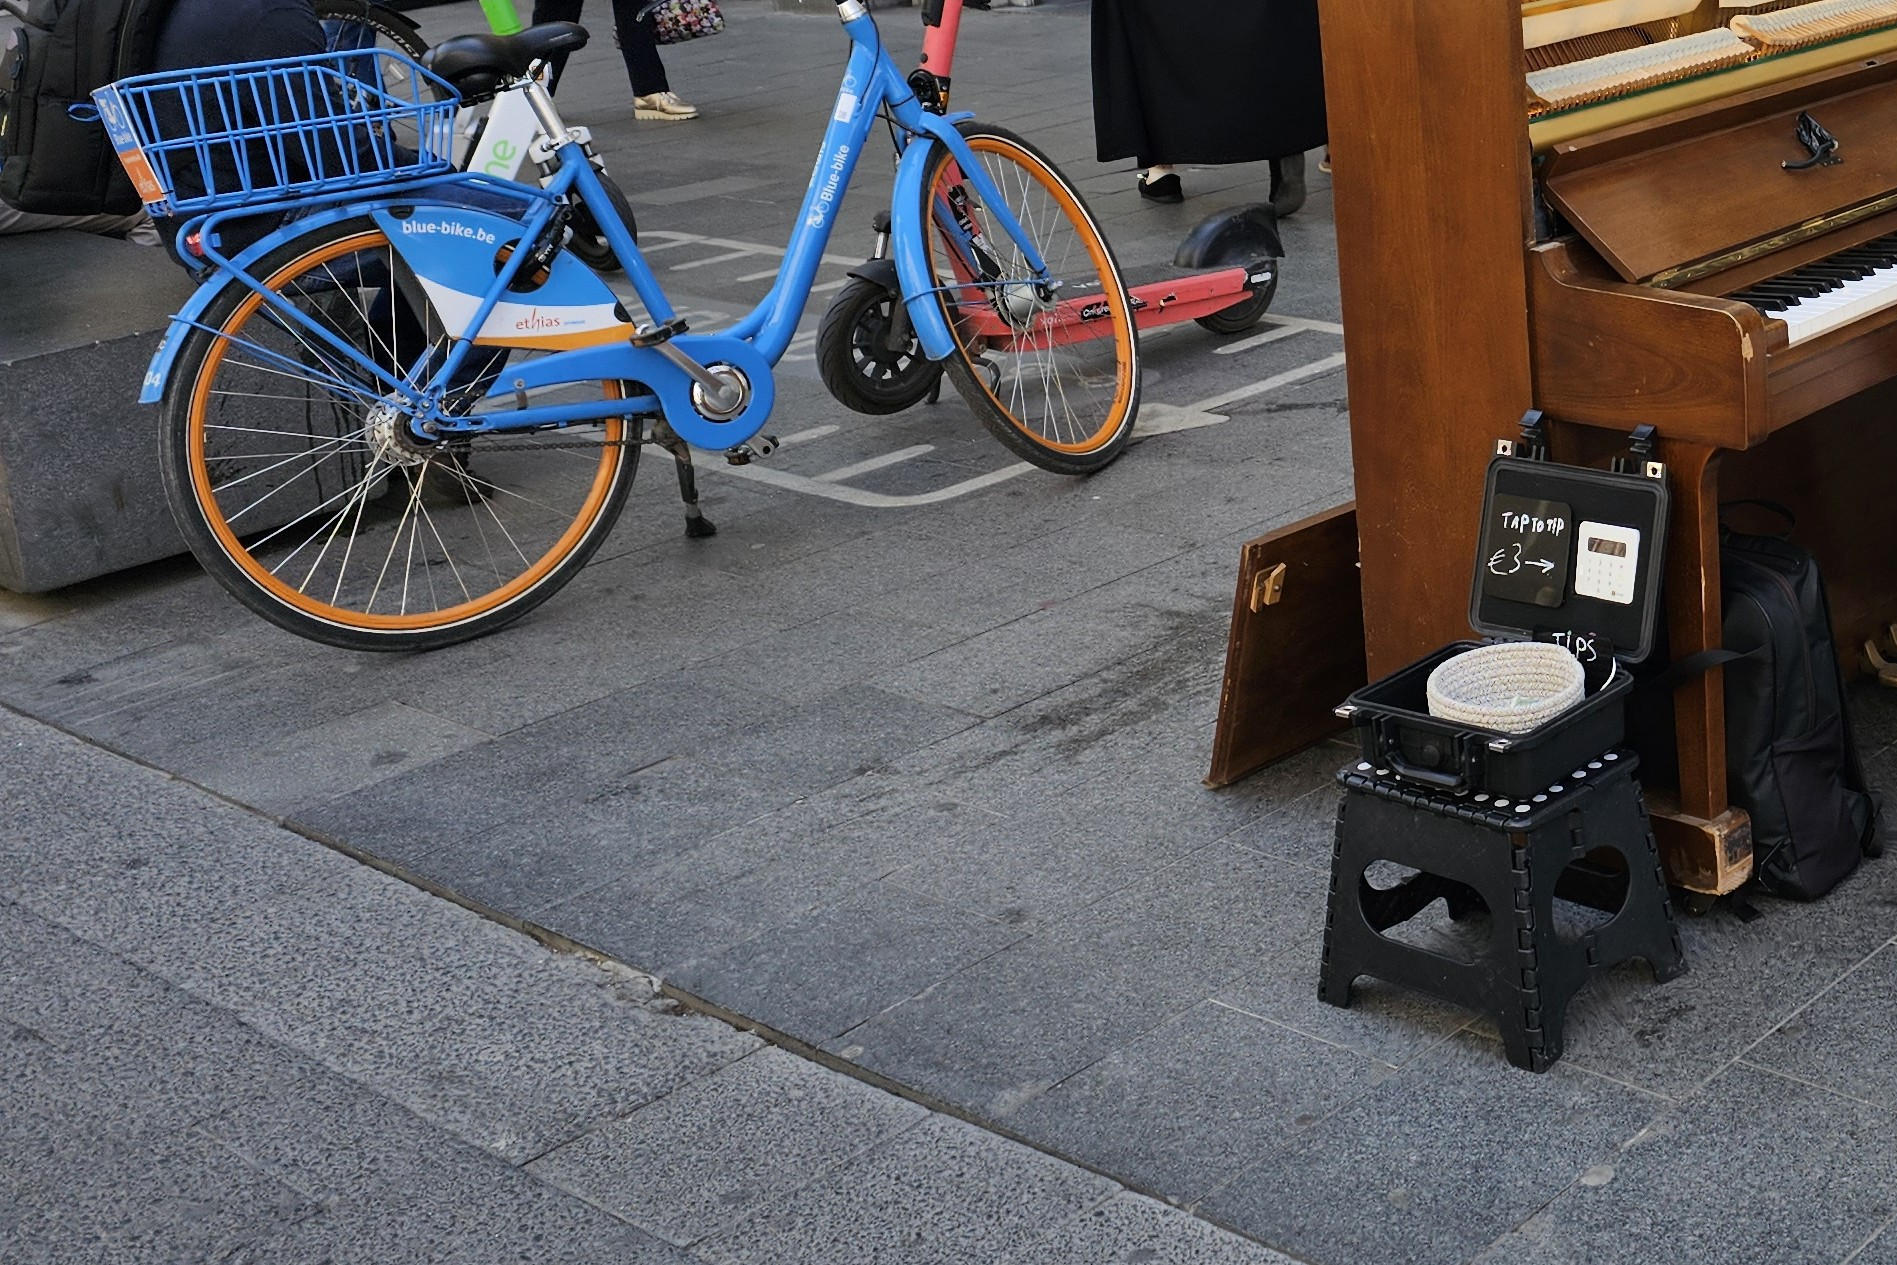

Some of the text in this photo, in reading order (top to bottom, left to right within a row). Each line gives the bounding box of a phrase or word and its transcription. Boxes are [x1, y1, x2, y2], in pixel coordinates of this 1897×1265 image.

[820, 144, 850, 203] Blue-bike
[402, 220, 496, 245] blue-bike.be
[515, 307, 561, 332] ethias
[1487, 542, 1522, 576] €3
